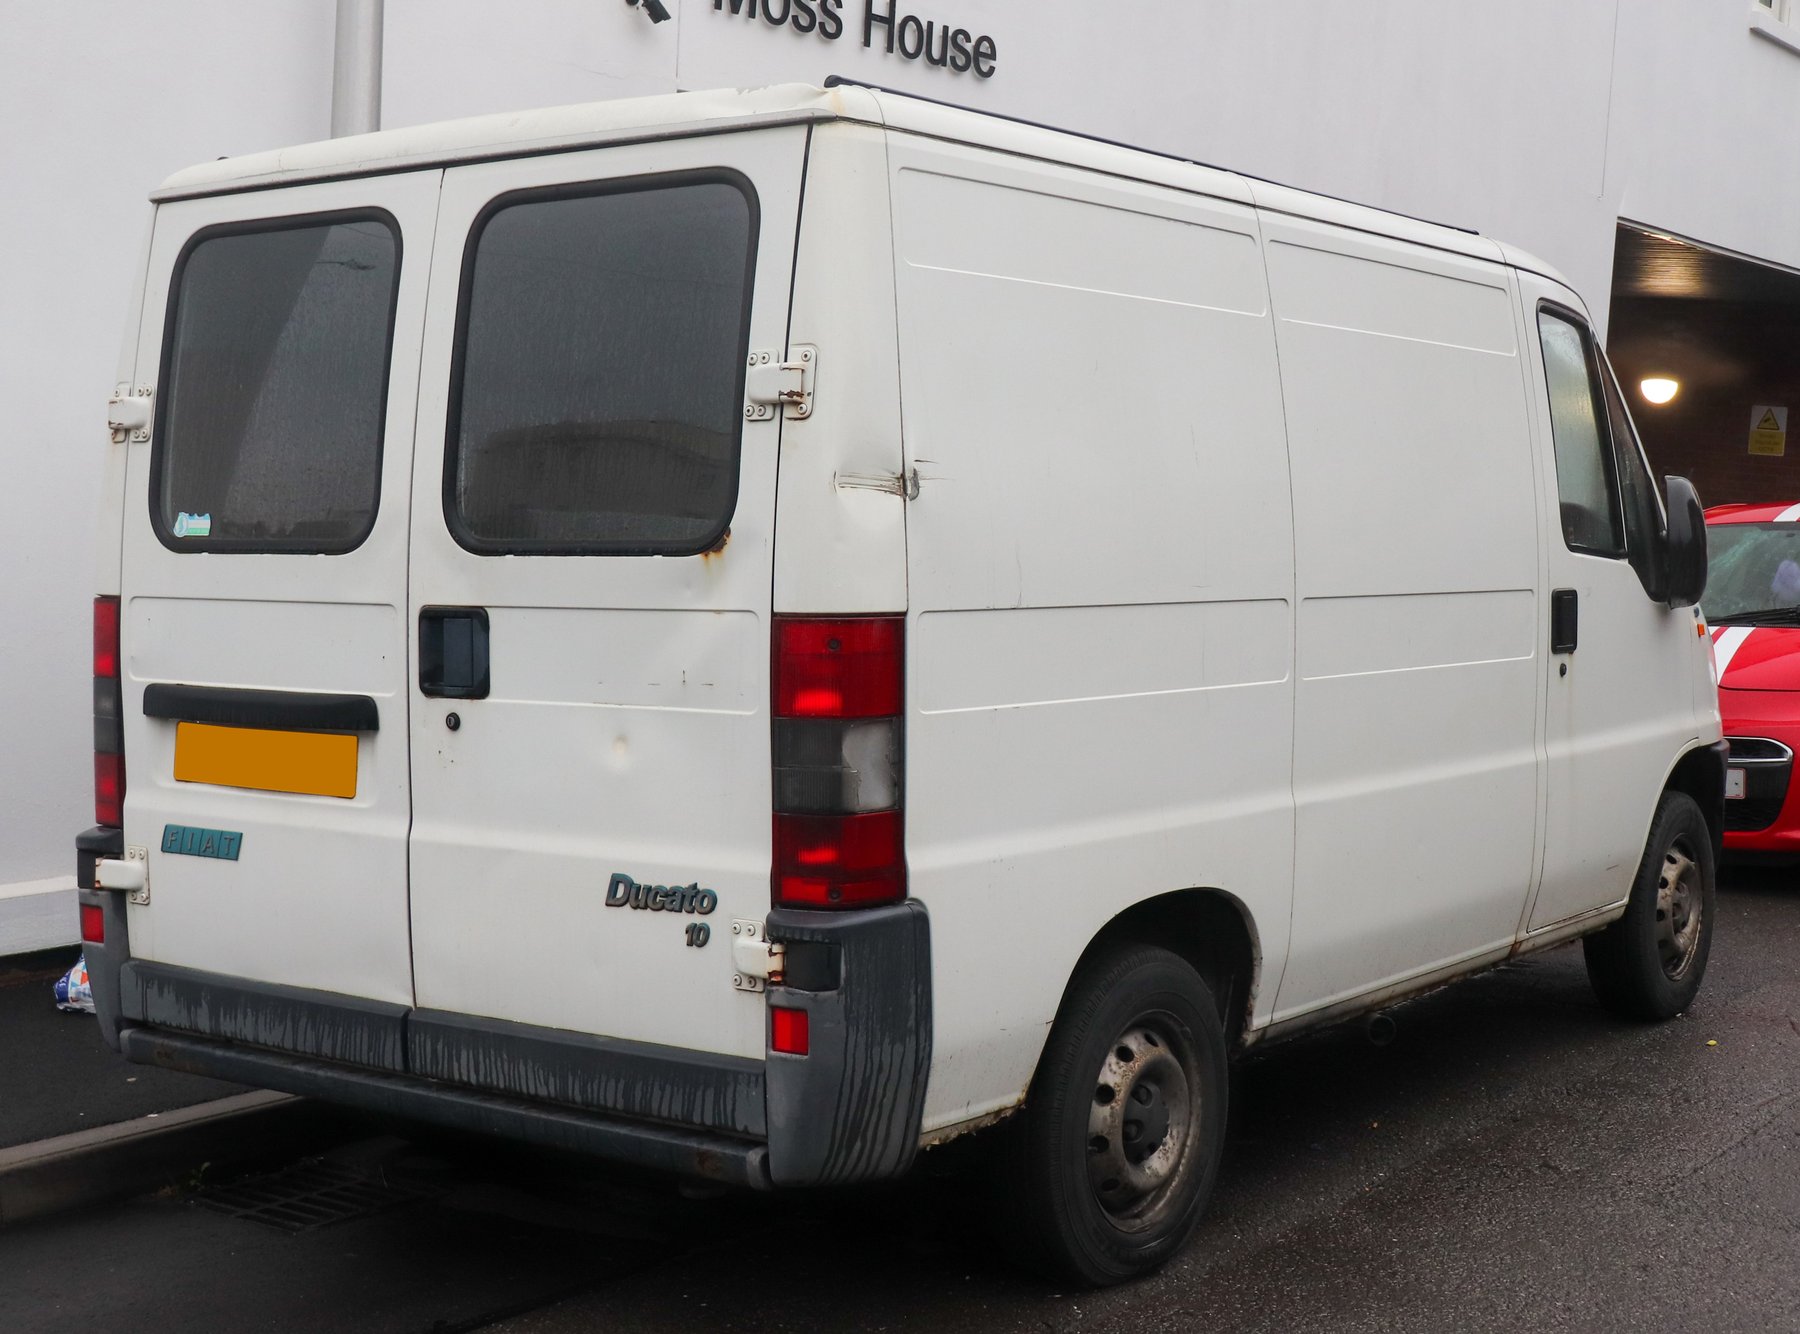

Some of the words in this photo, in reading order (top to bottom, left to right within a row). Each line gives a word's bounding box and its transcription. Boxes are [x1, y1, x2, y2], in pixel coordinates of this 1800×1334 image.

[714, 0, 843, 40] oss
[863, 0, 997, 79] House
[165, 829, 236, 857] FIAT
[605, 873, 718, 915] Ducato
[685, 922, 711, 948] 10
